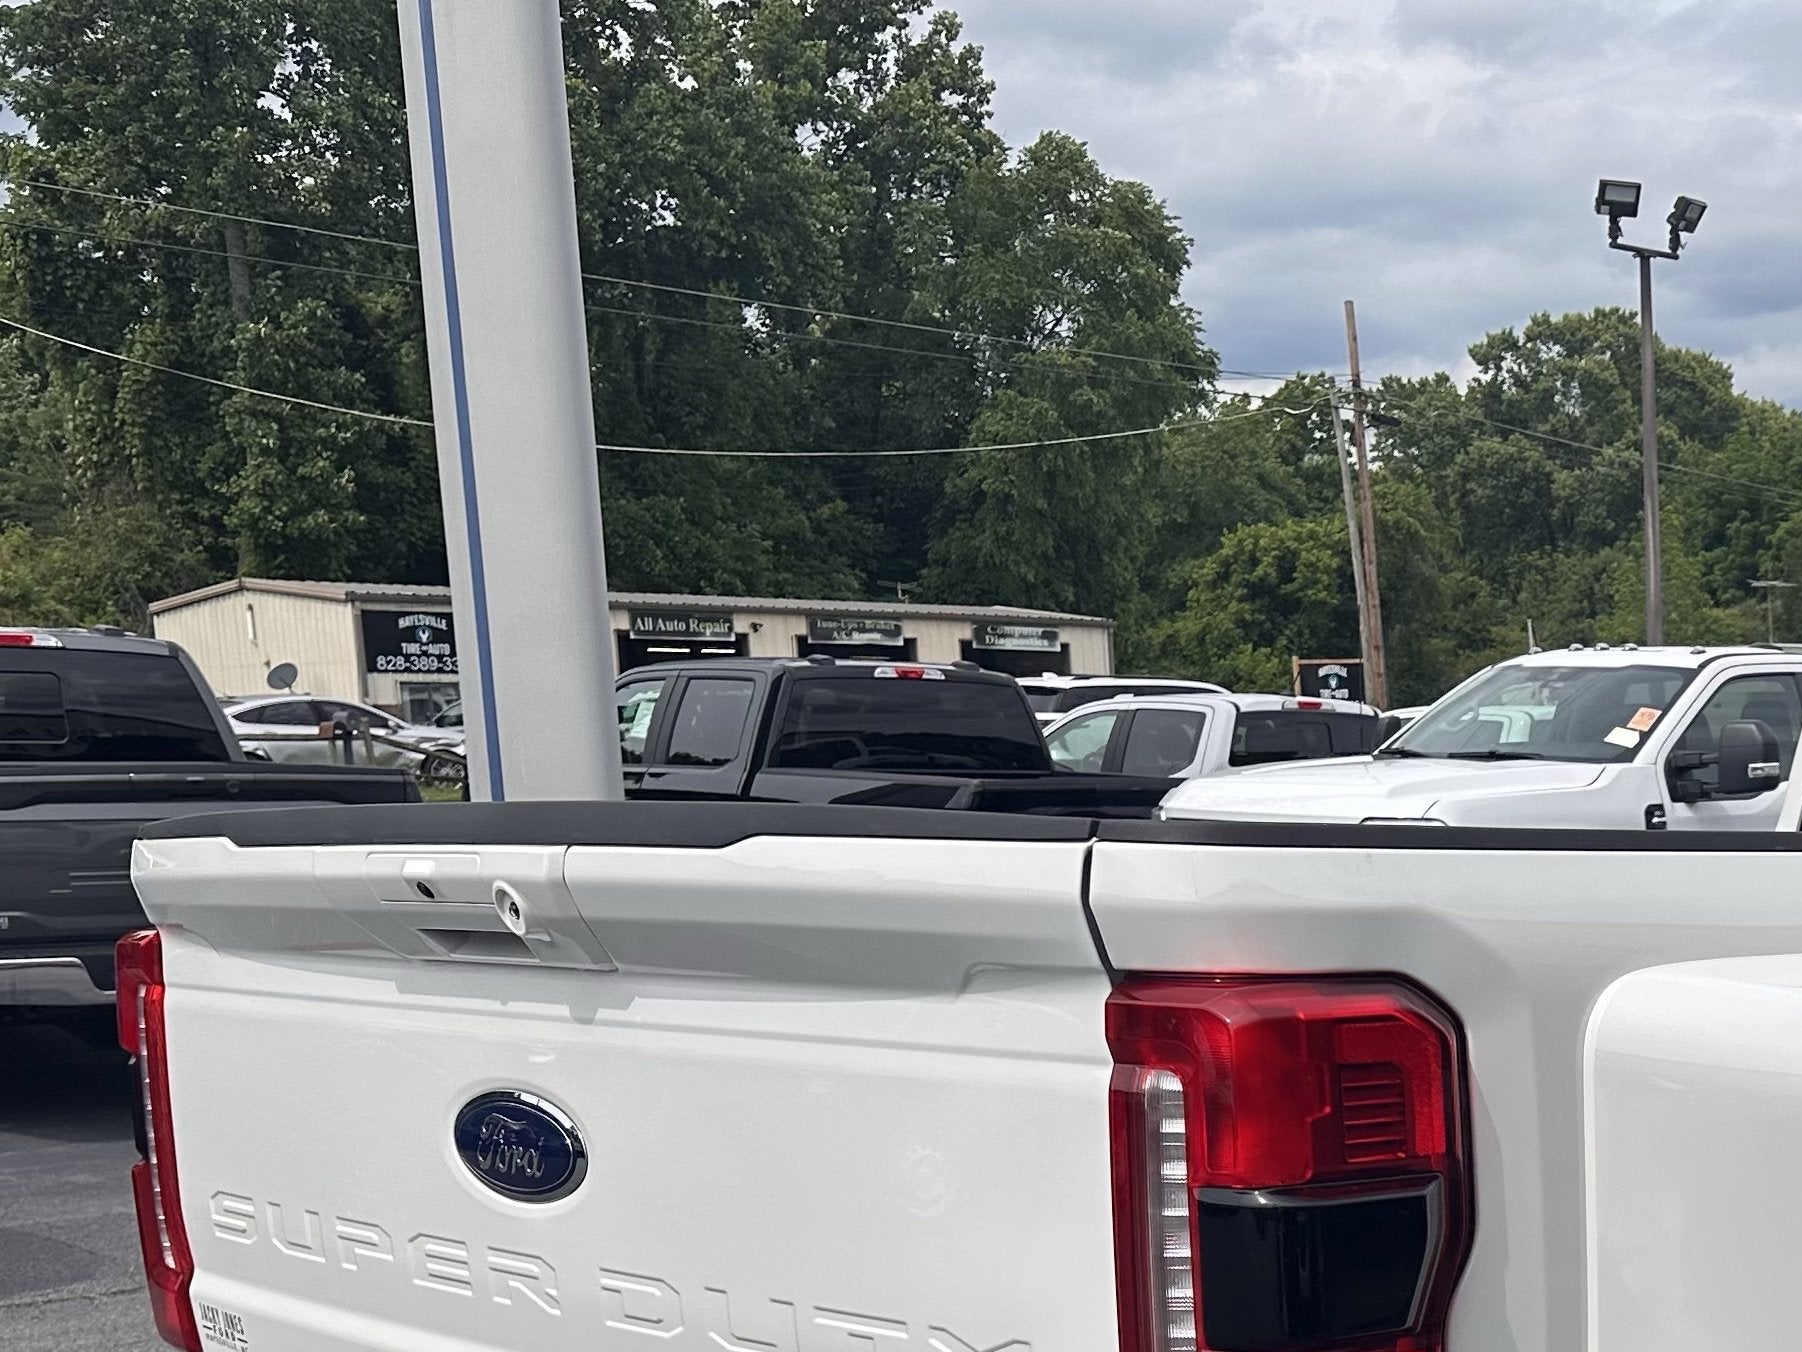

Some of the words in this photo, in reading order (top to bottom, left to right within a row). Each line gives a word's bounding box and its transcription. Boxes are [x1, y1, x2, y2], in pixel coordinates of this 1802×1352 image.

[634, 616, 653, 631] All
[655, 617, 686, 631] Auto
[689, 618, 731, 636] Repair
[401, 642, 422, 655] TIRE
[428, 643, 450, 655] AUTO
[208, 1189, 562, 1315] SUPER
